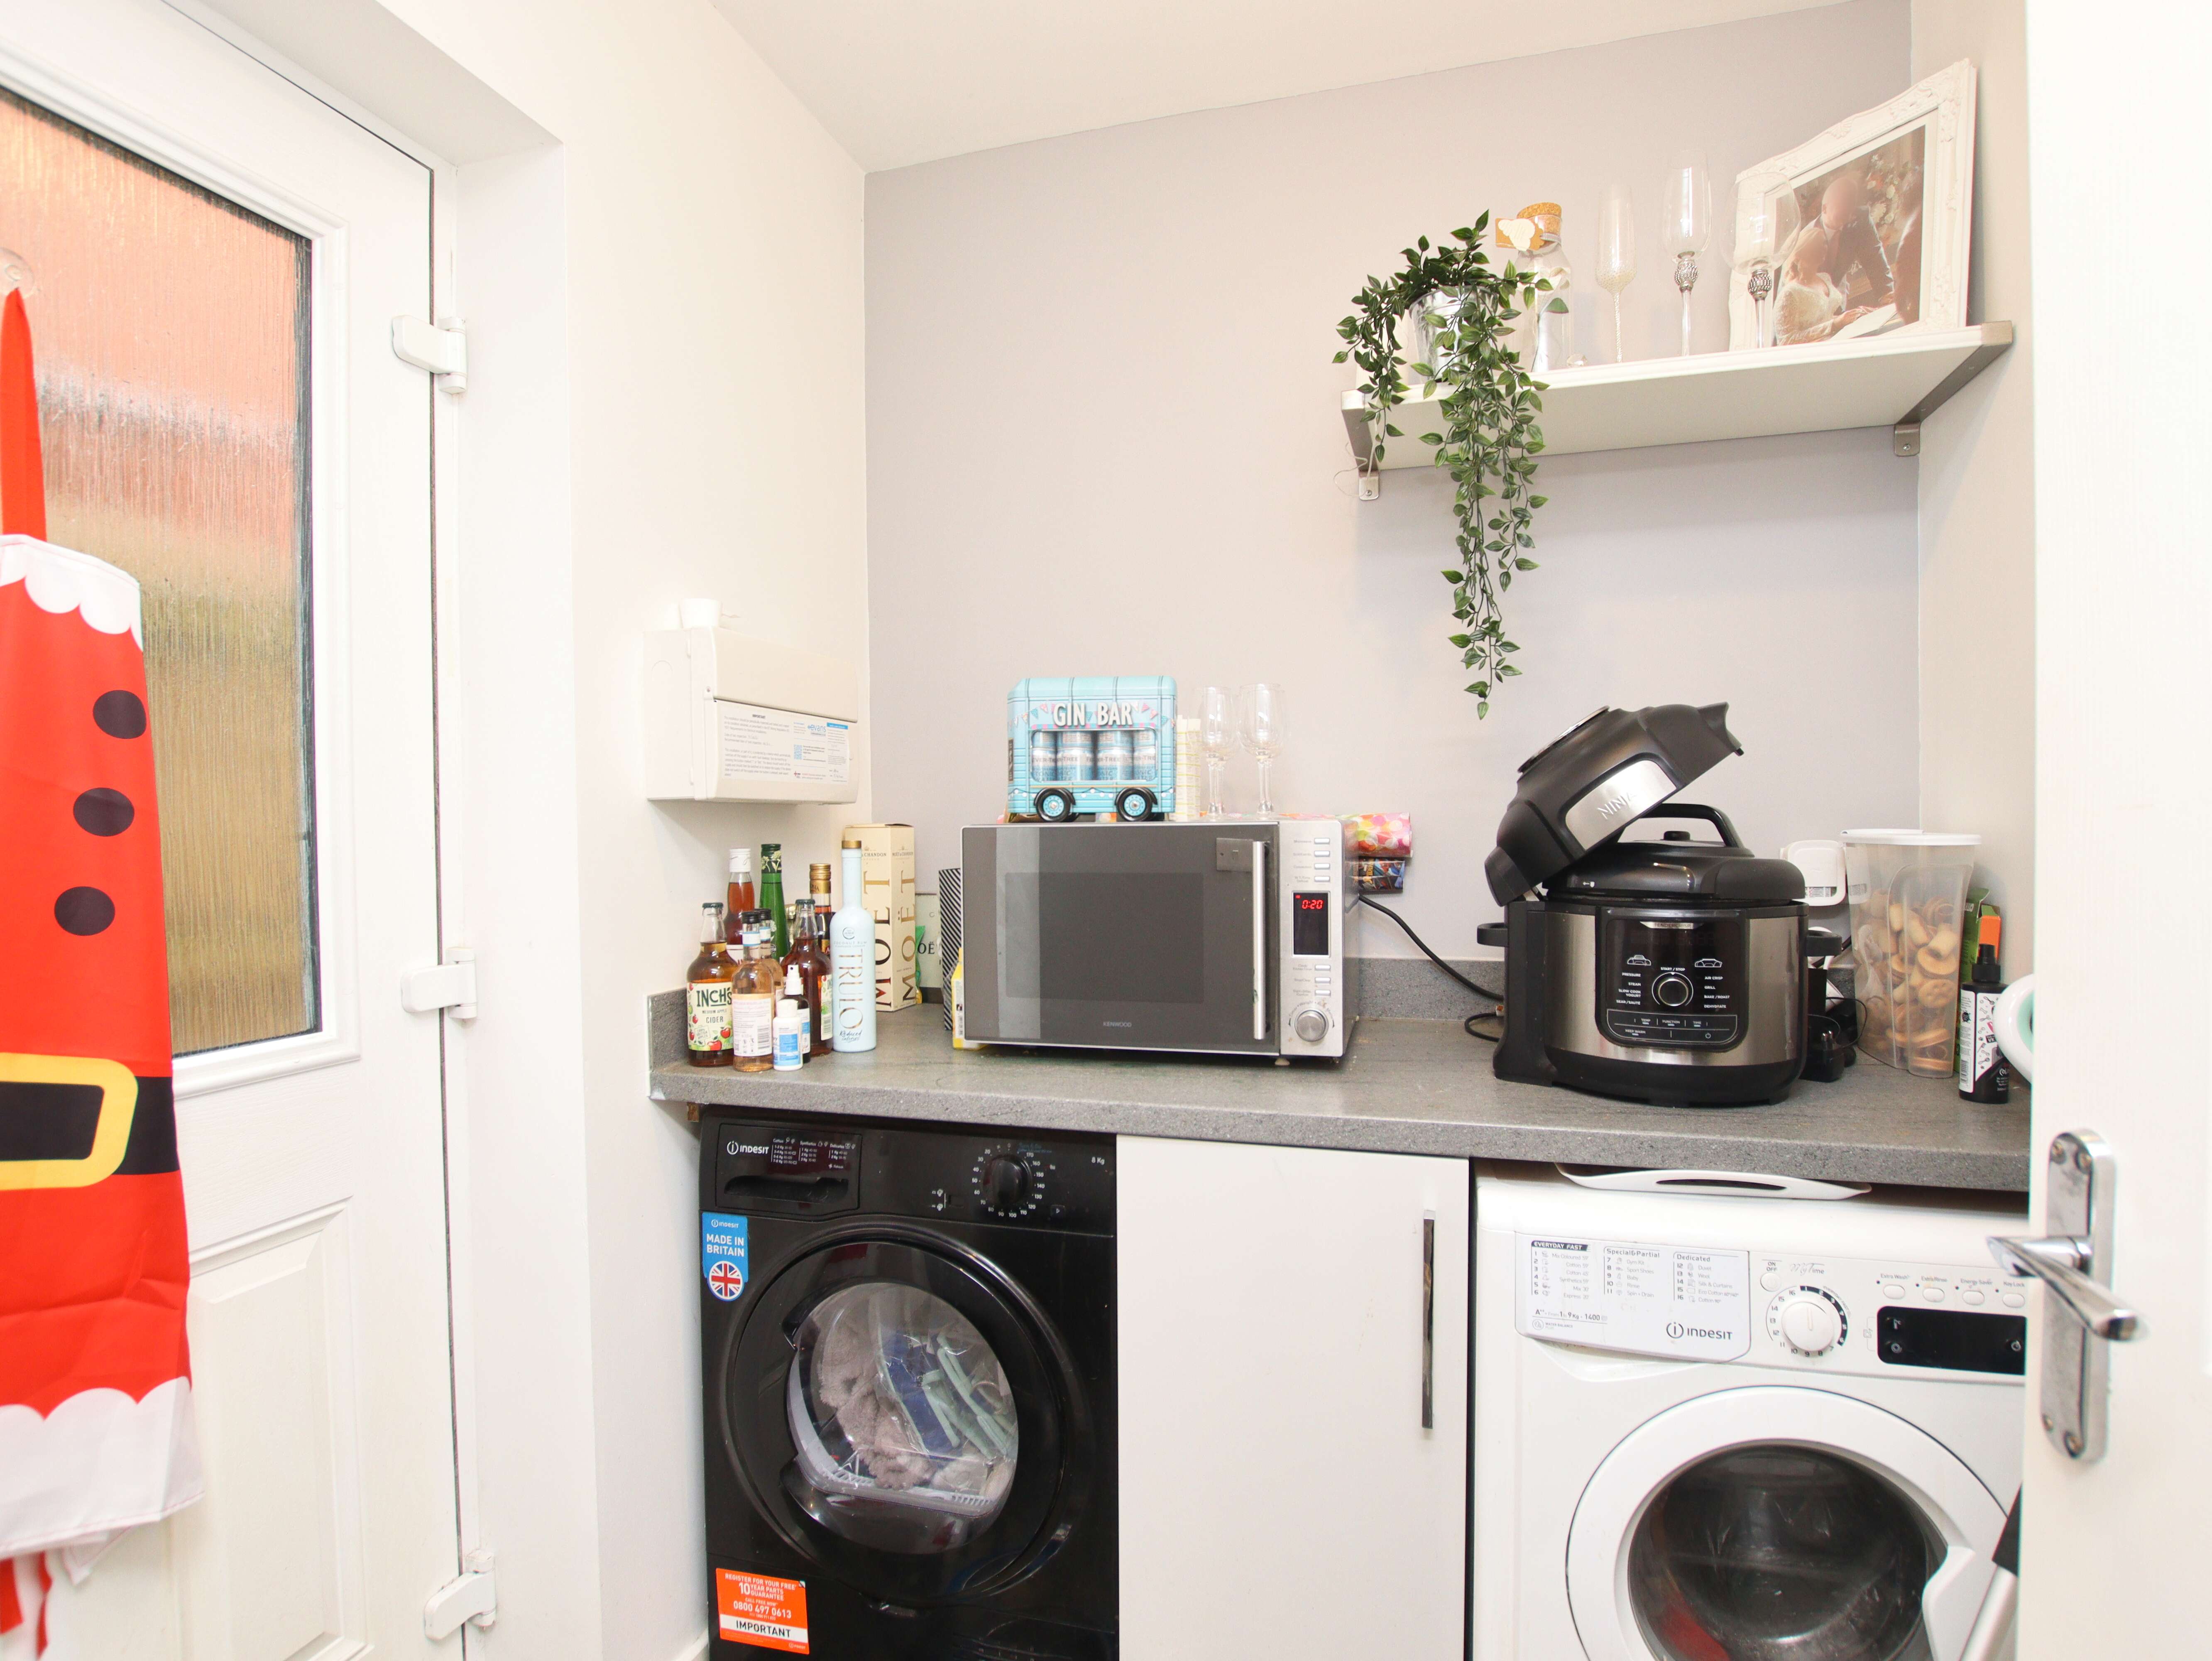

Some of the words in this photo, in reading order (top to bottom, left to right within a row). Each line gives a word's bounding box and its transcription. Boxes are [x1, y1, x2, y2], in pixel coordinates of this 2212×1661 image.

[1054, 702, 1086, 726] GIN
[1097, 702, 1133, 726] BAR
[811, 724, 826, 733] evans
[1302, 900, 1323, 909] 0:20
[839, 948, 863, 1029] TRULO
[1097, 1157, 1105, 1165] Kg
[707, 1233, 732, 1245] MADE
[734, 1236, 744, 1246] IN
[707, 1244, 744, 1257] BRITAIN
[725, 1574, 751, 1582] REGISTER
[739, 1582, 751, 1595] 10
[766, 1586, 783, 1595] PARTS
[751, 1590, 784, 1601] GUARANTEE
[733, 1601, 753, 1611] 0800
[755, 1605, 769, 1614] 497
[771, 1608, 791, 1619] 0613
[736, 1620, 790, 1637] IMPORTANT
